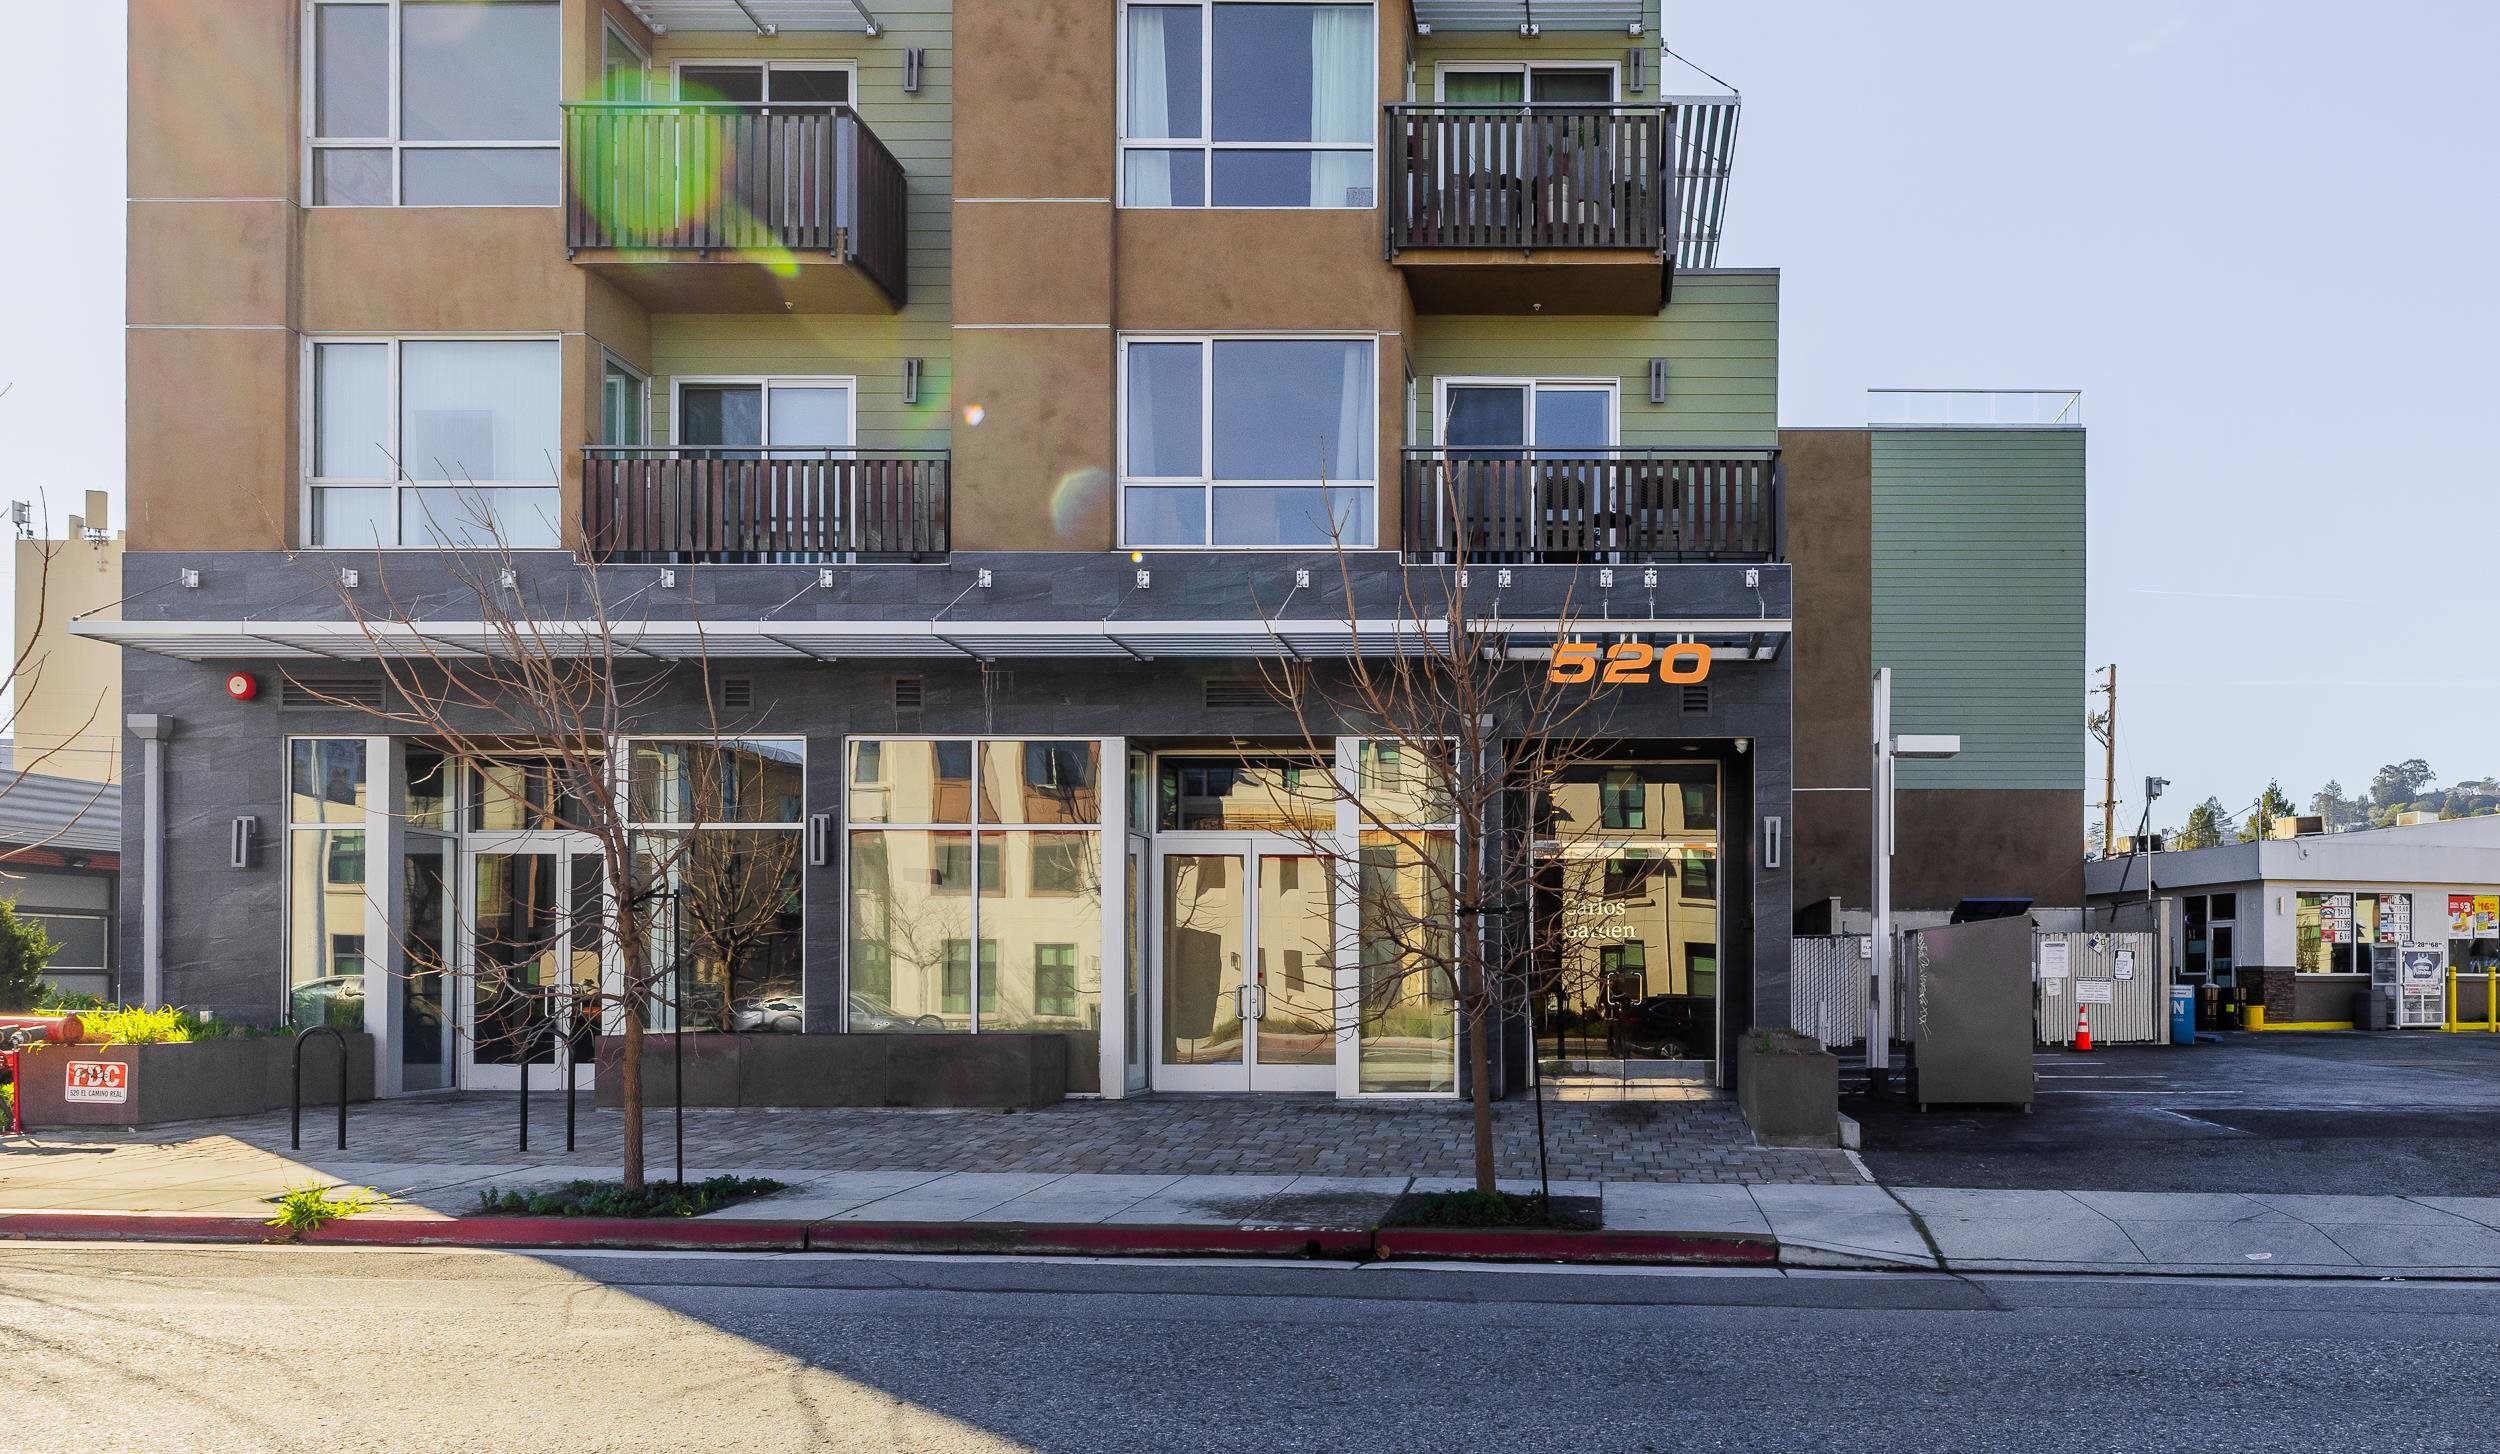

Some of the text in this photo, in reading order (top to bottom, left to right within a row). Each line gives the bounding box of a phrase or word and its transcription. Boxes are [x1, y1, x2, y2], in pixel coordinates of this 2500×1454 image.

[1549, 643, 1712, 684] 520
[1563, 897, 1626, 916] Carlos
[2460, 902, 2471, 912] $3
[74, 1064, 120, 1087] FDC
[88, 1090, 108, 1098] CAMINO
